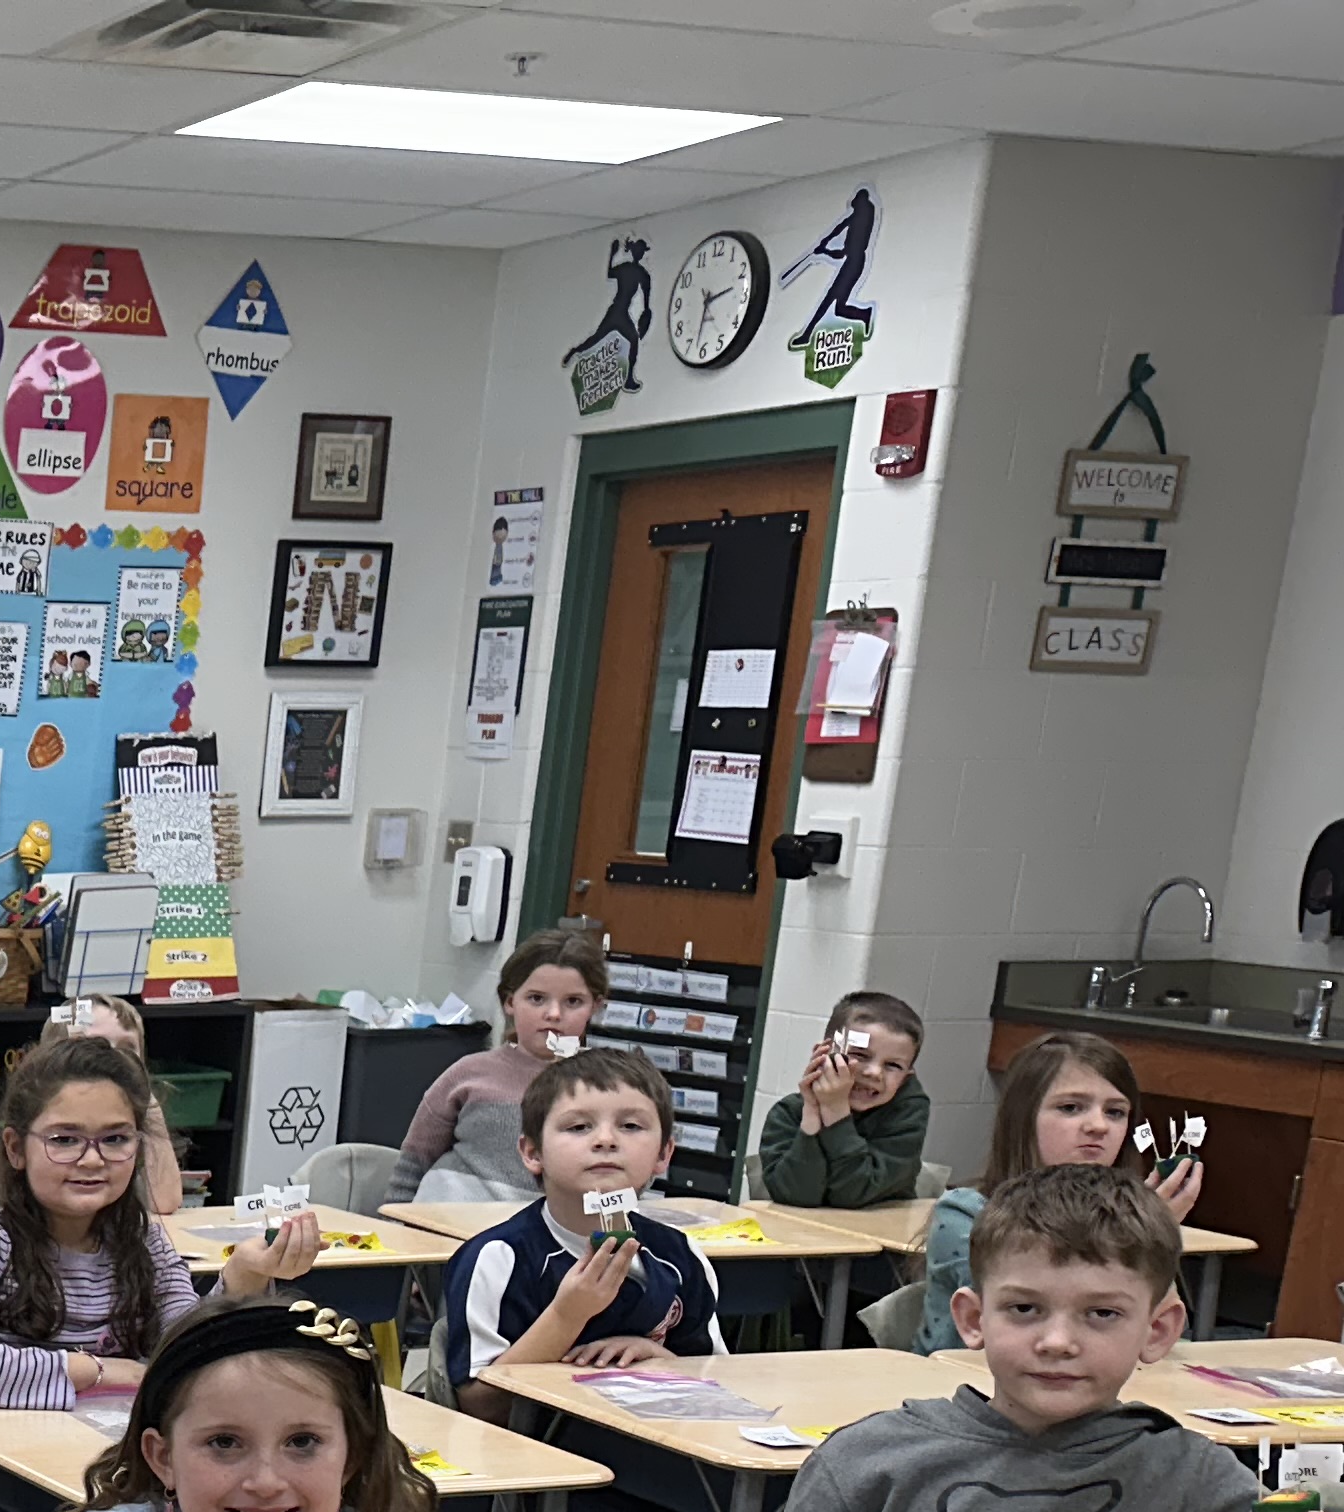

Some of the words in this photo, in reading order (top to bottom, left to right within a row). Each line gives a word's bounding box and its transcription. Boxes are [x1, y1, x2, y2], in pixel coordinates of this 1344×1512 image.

[712, 240, 725, 256] 12
[696, 252, 707, 268] 11
[738, 262, 747, 279] 2
[680, 272, 692, 289] 10
[35, 292, 152, 327] trapezoid
[674, 298, 682, 314] 9
[676, 321, 684, 337] 8
[716, 335, 724, 351] 5
[816, 328, 852, 352] Home
[578, 337, 620, 376] Practice
[699, 343, 707, 359] 6
[815, 344, 852, 371] Run!
[206, 349, 279, 375] rhombus
[583, 358, 618, 387] makes
[581, 370, 624, 408] Perfect!
[26, 449, 83, 474] ellipse
[881, 465, 902, 475] FIRE
[1075, 468, 1175, 494] WELCOME
[115, 477, 194, 505] square
[5, 530, 46, 546] RULES
[126, 581, 138, 590] Be
[140, 581, 160, 591] nice
[137, 597, 158, 607] your
[53, 619, 78, 630] Follow
[82, 619, 97, 629] all
[121, 612, 173, 622] teammates
[46, 636, 76, 645] school
[77, 635, 101, 645] rules
[1045, 626, 1146, 657] CLASS
[152, 834, 157, 843] in
[162, 830, 177, 840] the
[179, 831, 202, 842] game
[160, 905, 192, 914] Strike
[166, 951, 197, 960] Strike
